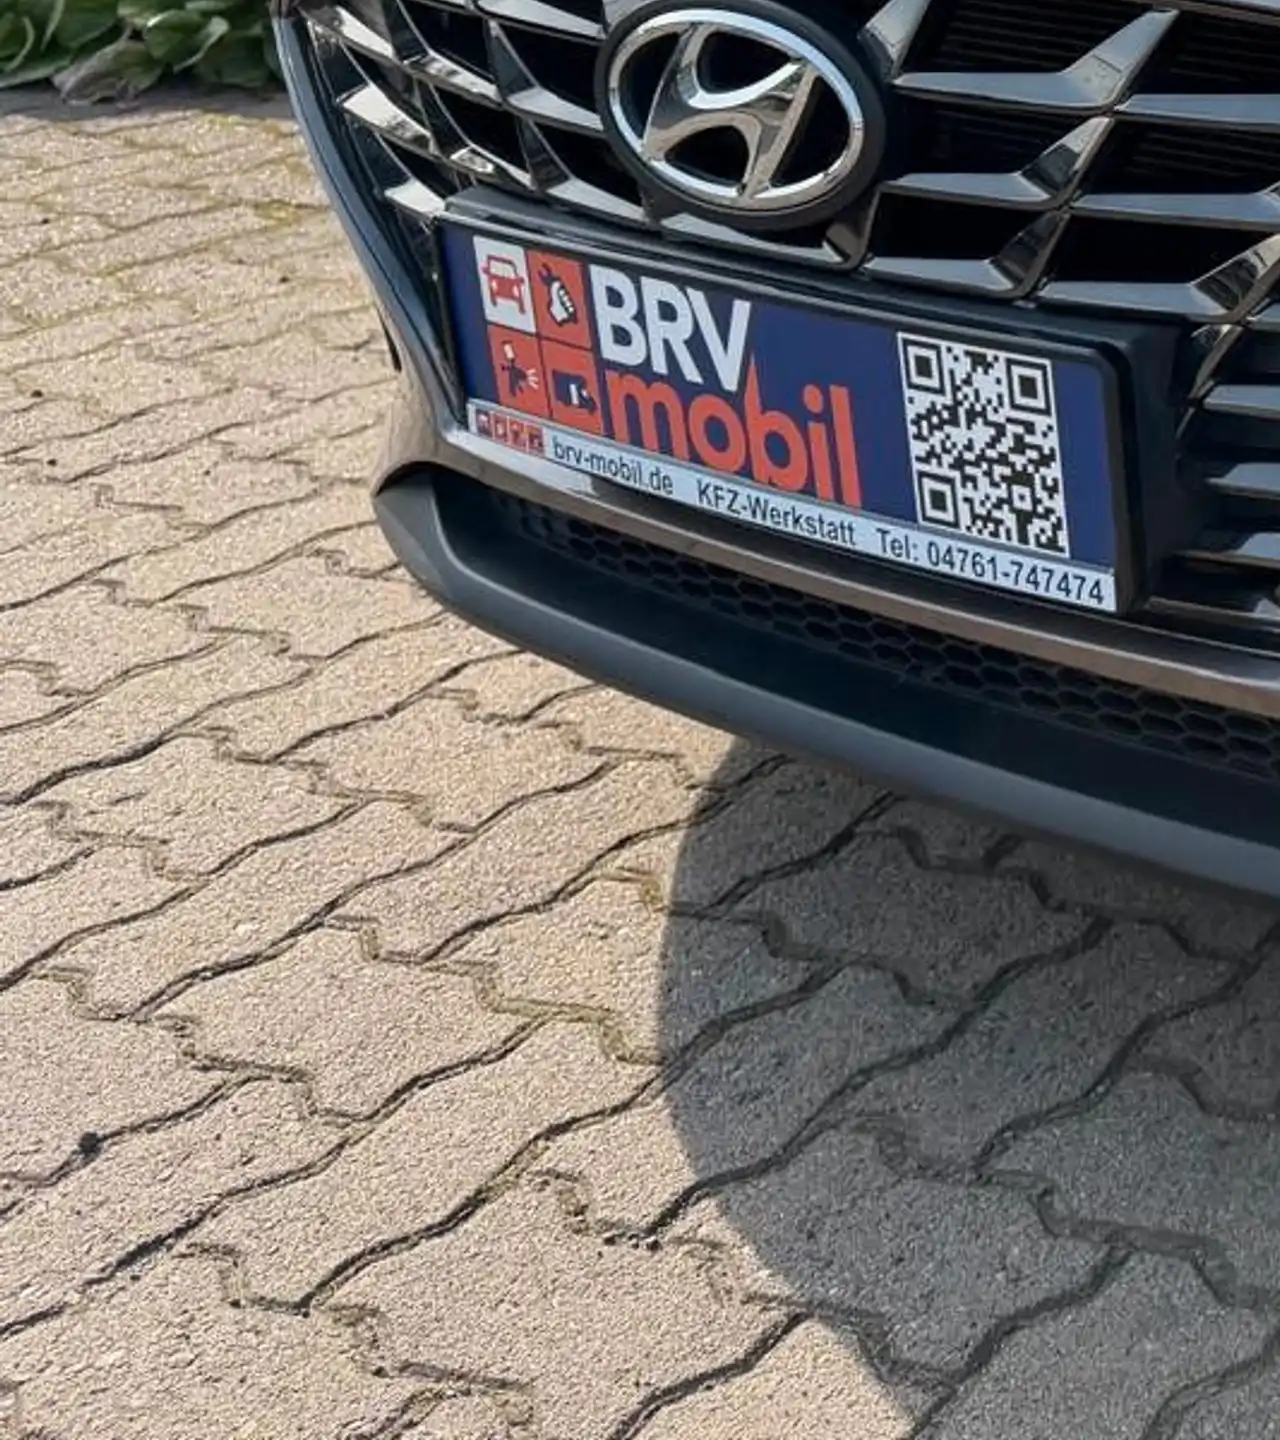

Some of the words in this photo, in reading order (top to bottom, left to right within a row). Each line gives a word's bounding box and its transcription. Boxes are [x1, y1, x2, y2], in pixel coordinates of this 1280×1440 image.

[588, 263, 751, 393] BRV
[604, 352, 862, 511] mobil
[551, 435, 674, 496] brv-mobil.de
[697, 478, 857, 546] KFZ-Werkstatt
[876, 528, 919, 561] Tel:
[926, 540, 1105, 604] 04761-747474
